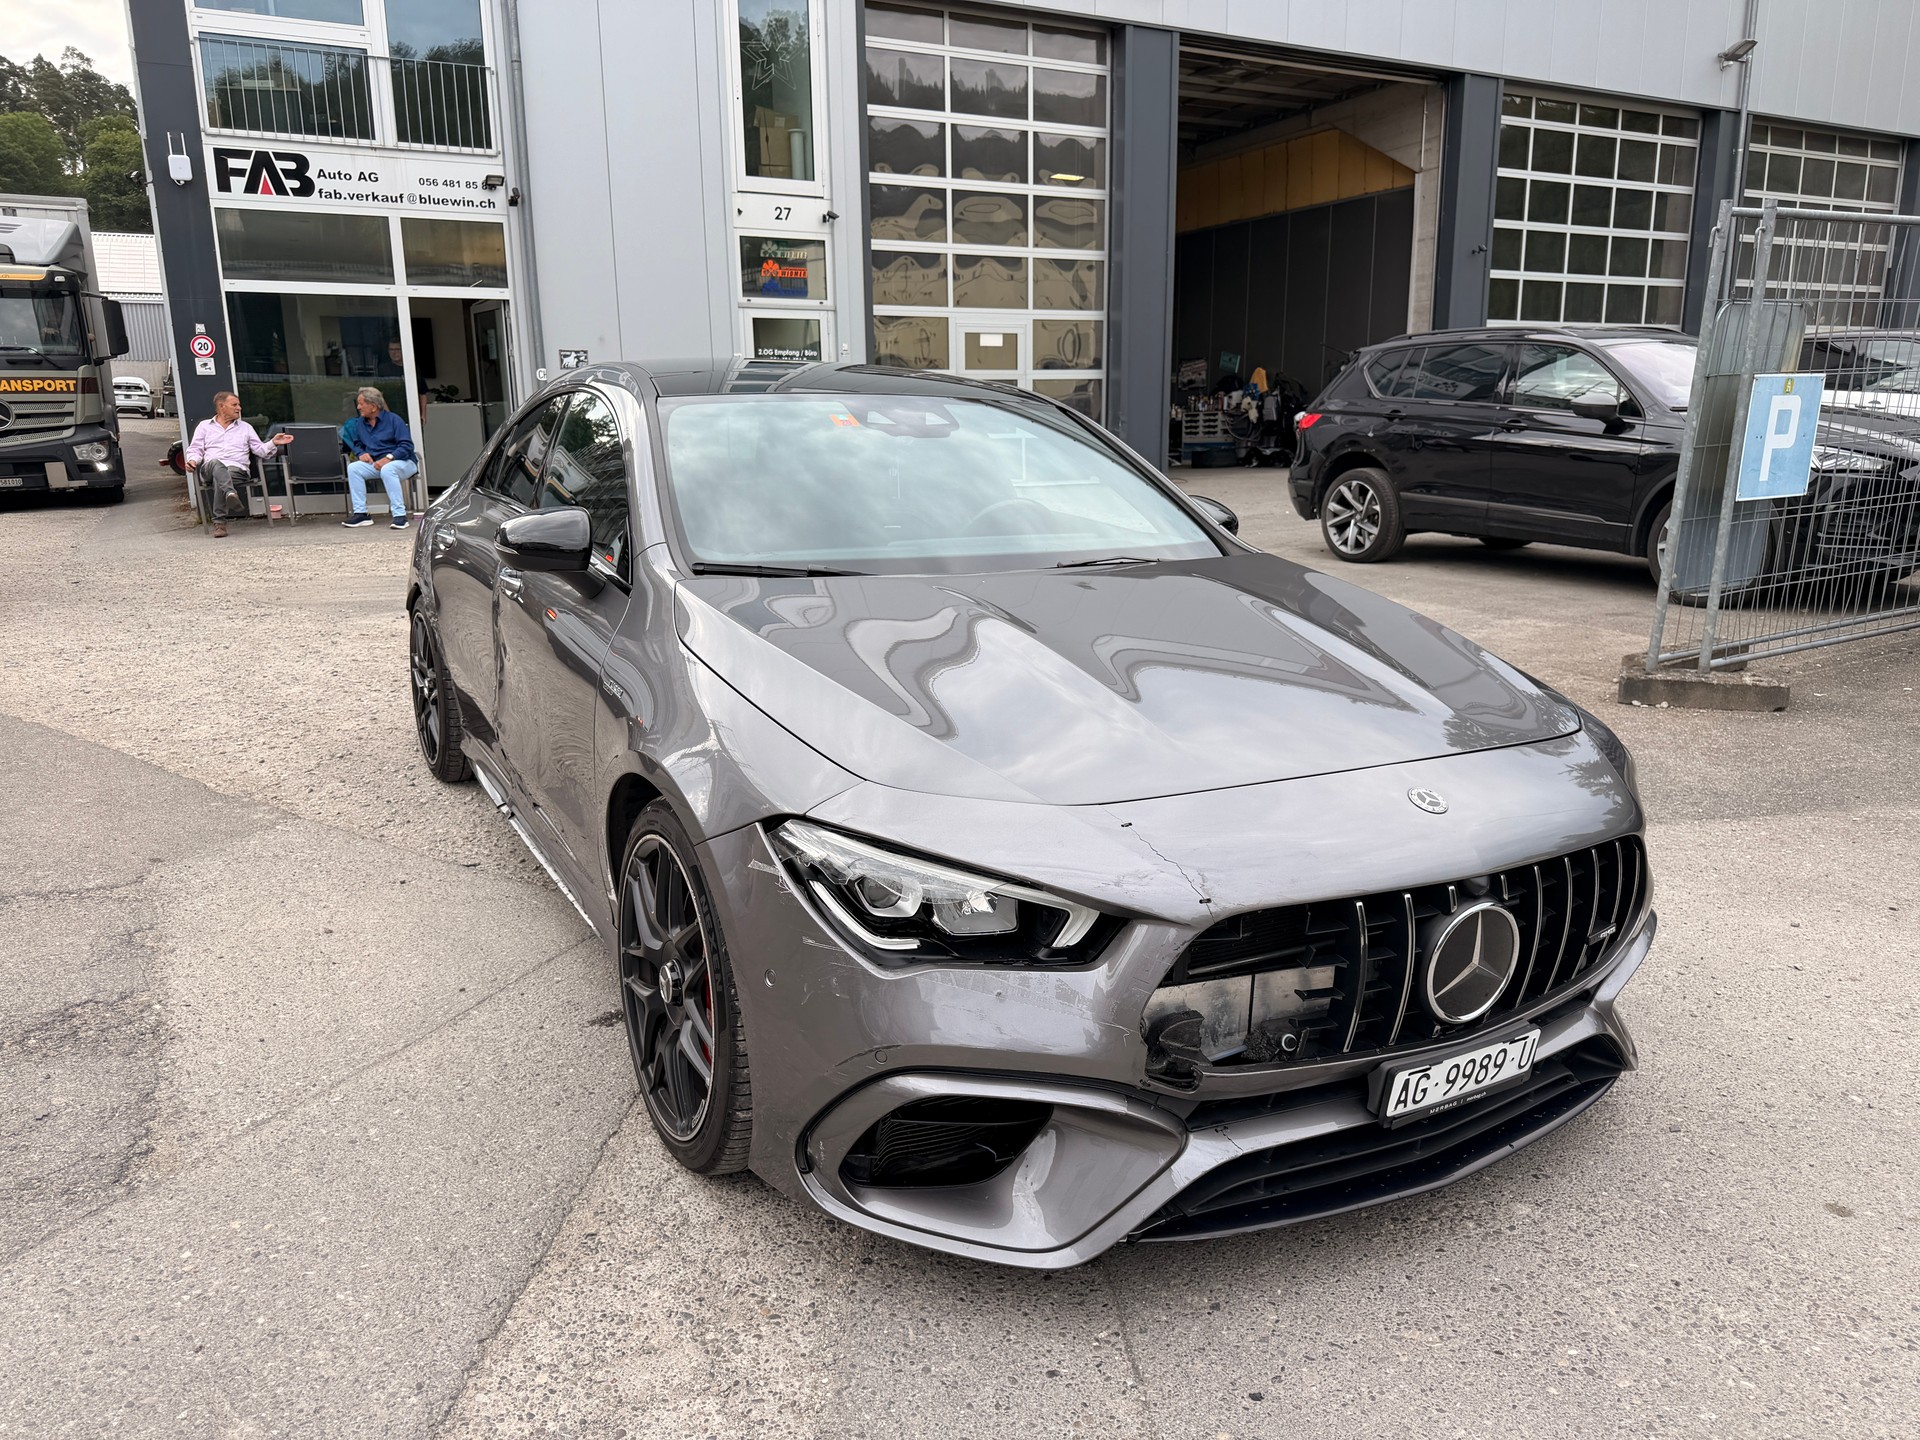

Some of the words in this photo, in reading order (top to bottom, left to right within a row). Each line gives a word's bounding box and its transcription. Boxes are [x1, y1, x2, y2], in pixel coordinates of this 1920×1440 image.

[213, 147, 316, 198] FAB
[317, 168, 352, 181] Auto
[357, 171, 379, 183] AG
[418, 177, 439, 187] 056
[442, 179, 461, 188] 481
[465, 180, 478, 190] 85
[774, 206, 792, 221] 27
[197, 341, 209, 351] 20
[1759, 395, 1802, 481] P
[1429, 1101, 1458, 1115] MERBAG
